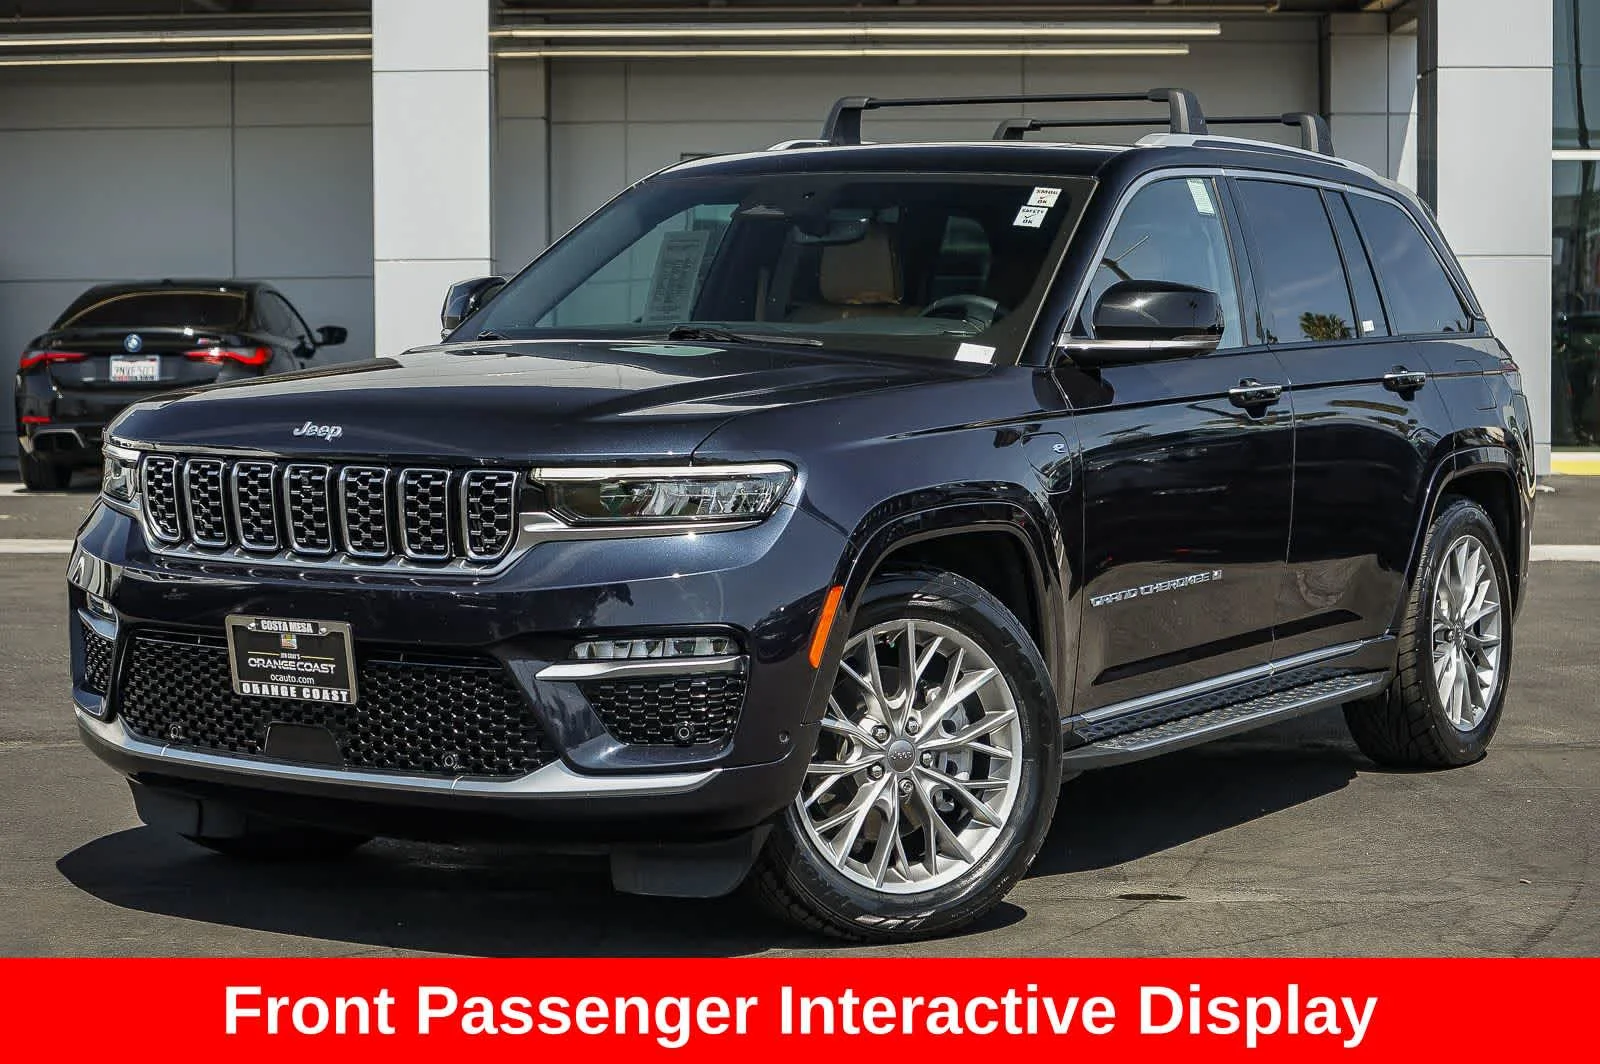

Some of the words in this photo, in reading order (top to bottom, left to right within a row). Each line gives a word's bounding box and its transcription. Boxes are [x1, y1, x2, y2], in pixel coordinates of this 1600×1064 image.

[292, 421, 343, 441] Jeep
[1090, 588, 1138, 607] GRAND
[1139, 572, 1210, 595] CHEROKEE
[260, 619, 288, 631] COSTA
[289, 621, 314, 633] MESA
[270, 673, 315, 684] ocauto.com
[242, 683, 297, 697] ORANGE
[302, 688, 348, 702] COAST
